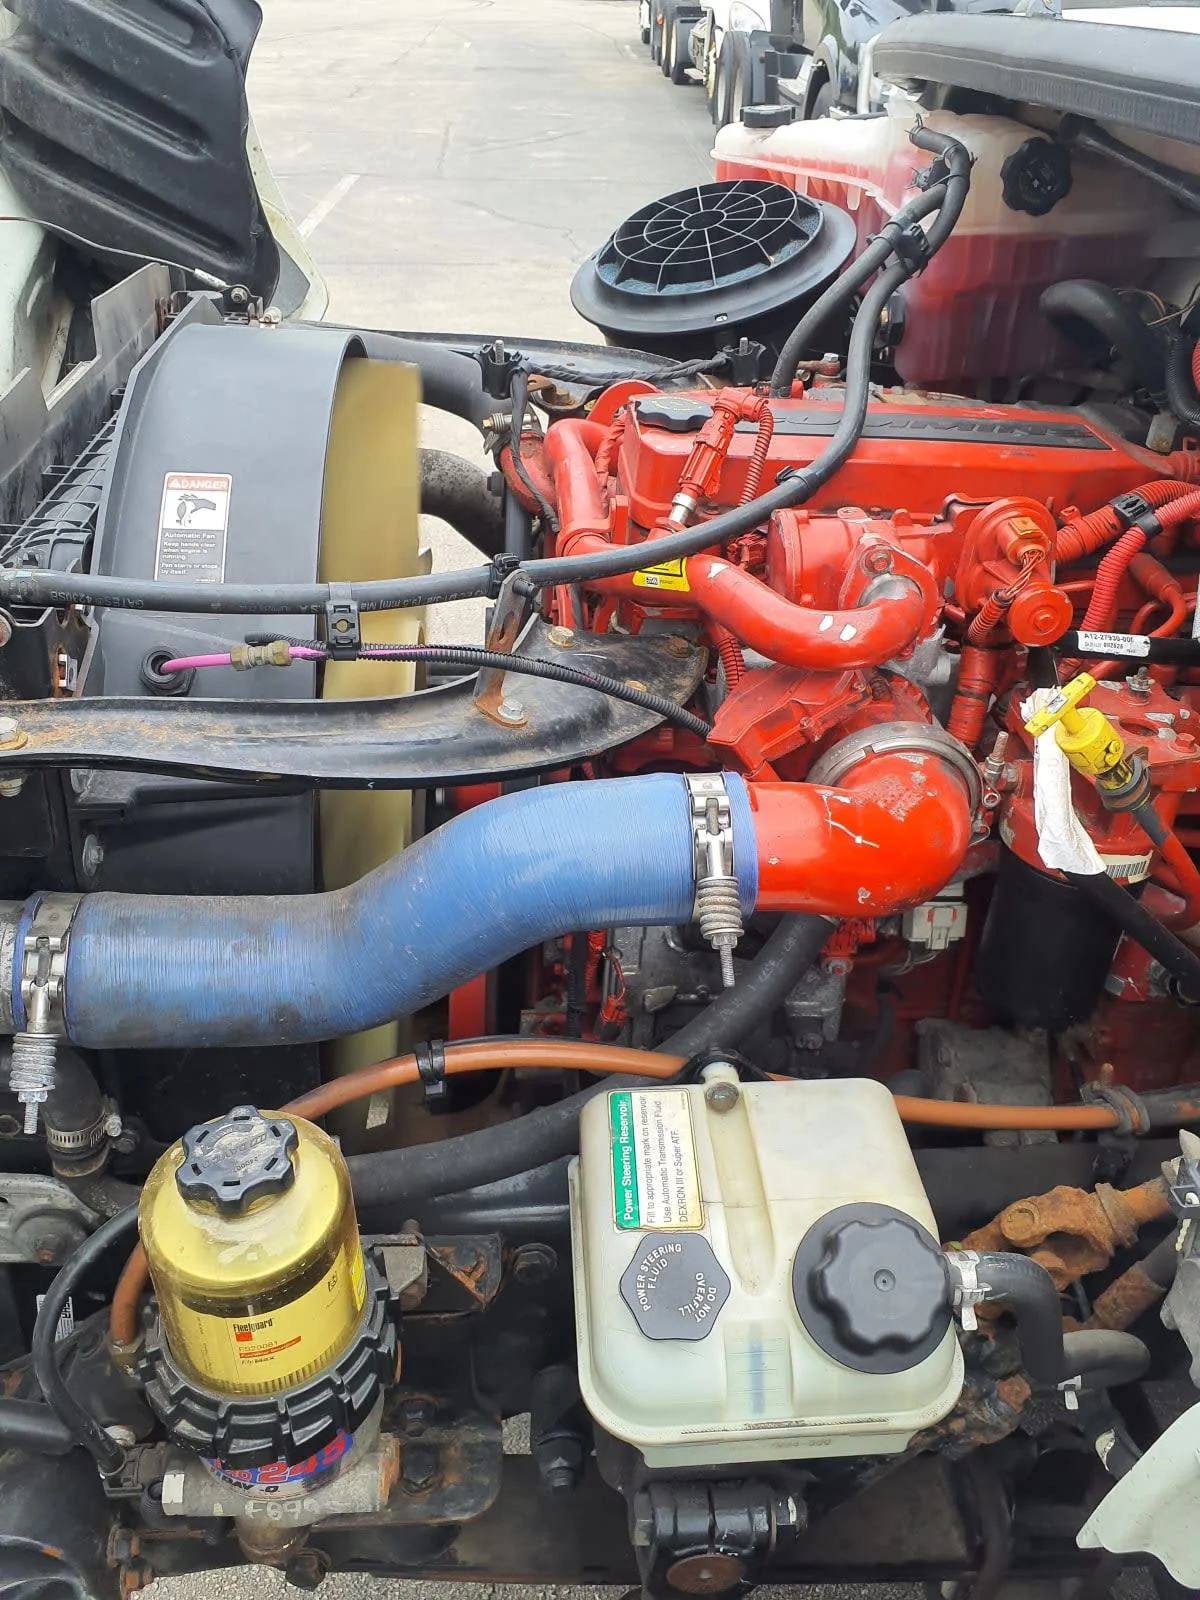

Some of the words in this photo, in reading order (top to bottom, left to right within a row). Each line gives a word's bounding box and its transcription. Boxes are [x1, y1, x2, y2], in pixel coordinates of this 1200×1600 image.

[182, 479, 227, 490] DANGER
[654, 1100, 662, 1118] Fluid
[619, 1100, 630, 1143] Reservoir
[641, 1128, 649, 1136] on
[641, 1137, 652, 1157] mark
[655, 1120, 667, 1166] Transmission
[621, 1145, 632, 1186] Steering
[672, 1147, 683, 1167] Super
[643, 1157, 655, 1200] appropriate
[675, 1177, 685, 1187] III
[678, 1167, 684, 1177] or
[660, 1167, 672, 1204] Automatic
[623, 1189, 634, 1221] Power
[647, 1202, 655, 1210] to
[663, 1207, 672, 1223] Use
[675, 1188, 689, 1223] DEXRON
[646, 1211, 656, 1224] Fill
[640, 1243, 682, 1272] STEERING
[647, 1258, 668, 1289] FLUID
[636, 1274, 652, 1312] POWER
[678, 1272, 706, 1317] OVERFILL
[706, 1286, 717, 1302] DO
[694, 1303, 711, 1323] NOT
[233, 1318, 273, 1335] Fleetguard
[221, 1475, 281, 1493] DAVO
